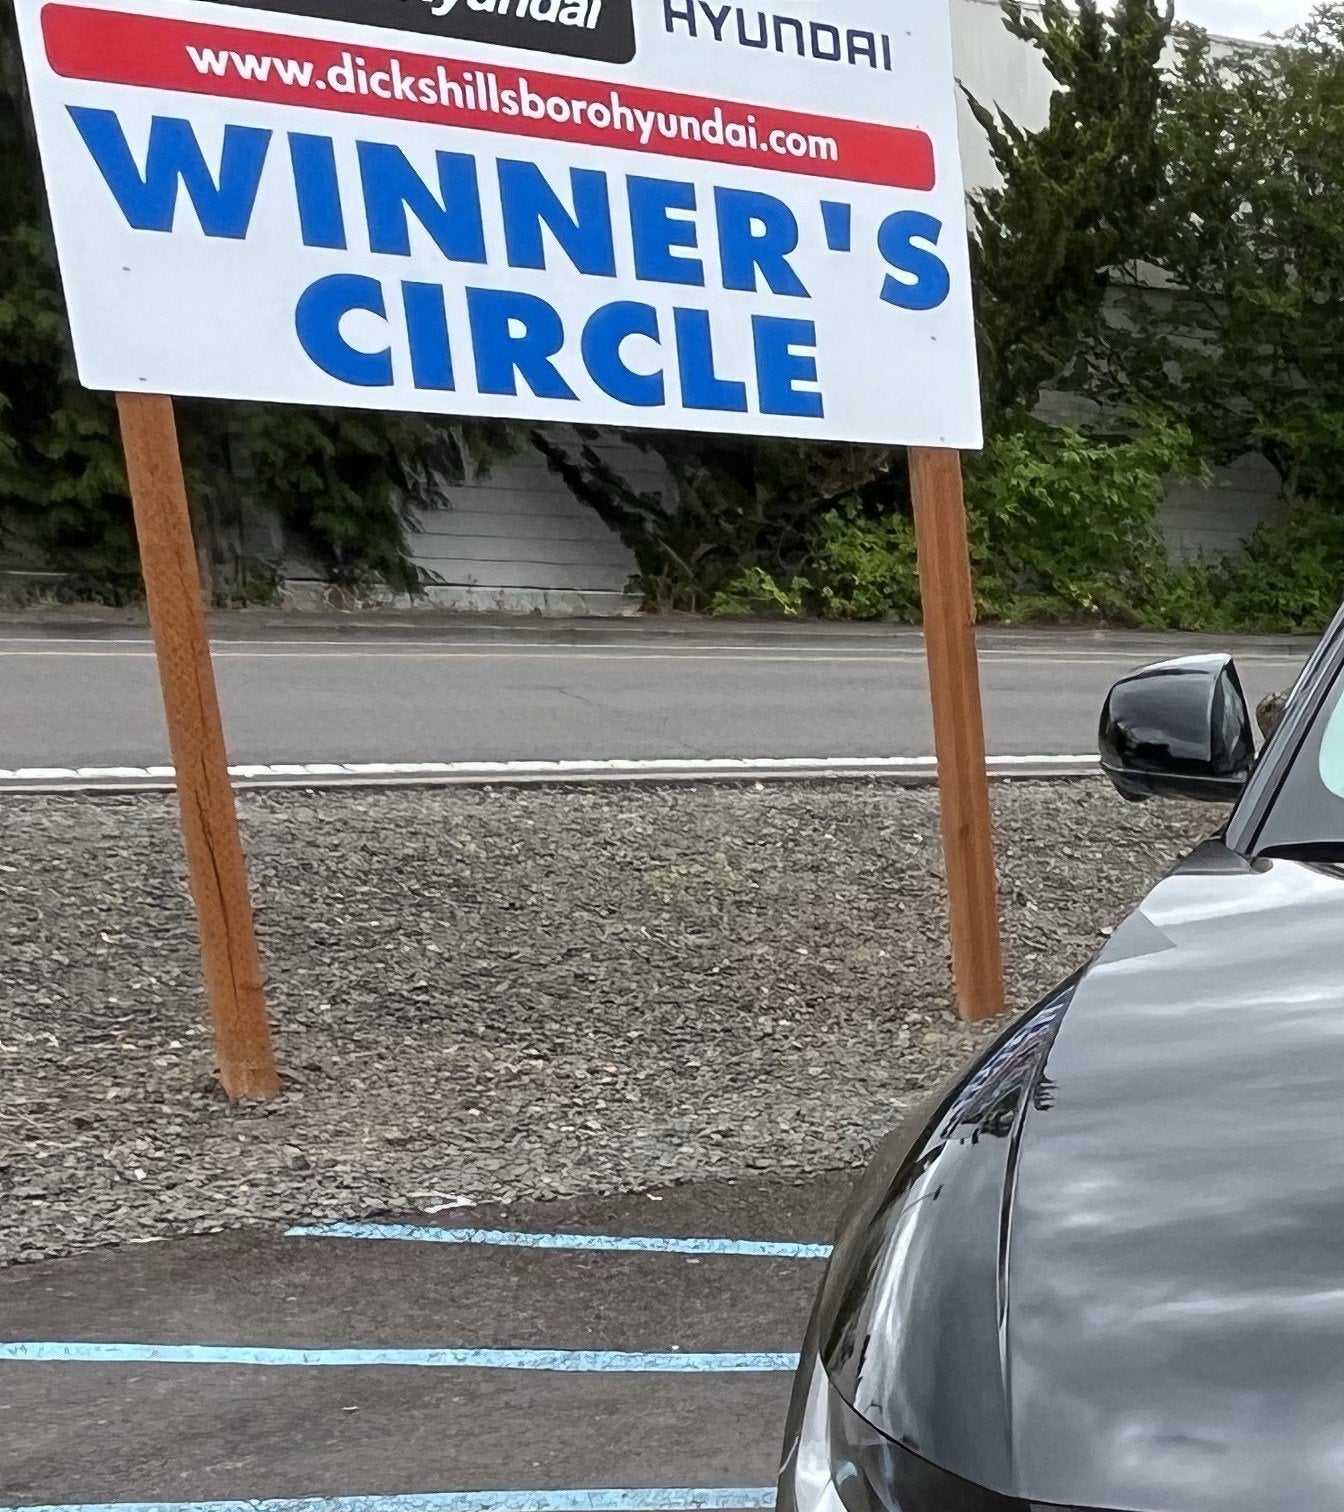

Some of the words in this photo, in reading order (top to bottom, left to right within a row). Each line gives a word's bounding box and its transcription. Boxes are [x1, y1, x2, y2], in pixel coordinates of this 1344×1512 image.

[663, 0, 892, 71] HYUNDAI
[186, 44, 838, 162] www.dickshillsborohyundai.com
[66, 104, 951, 311] WINNER'S
[295, 273, 824, 419] CIRCLE
